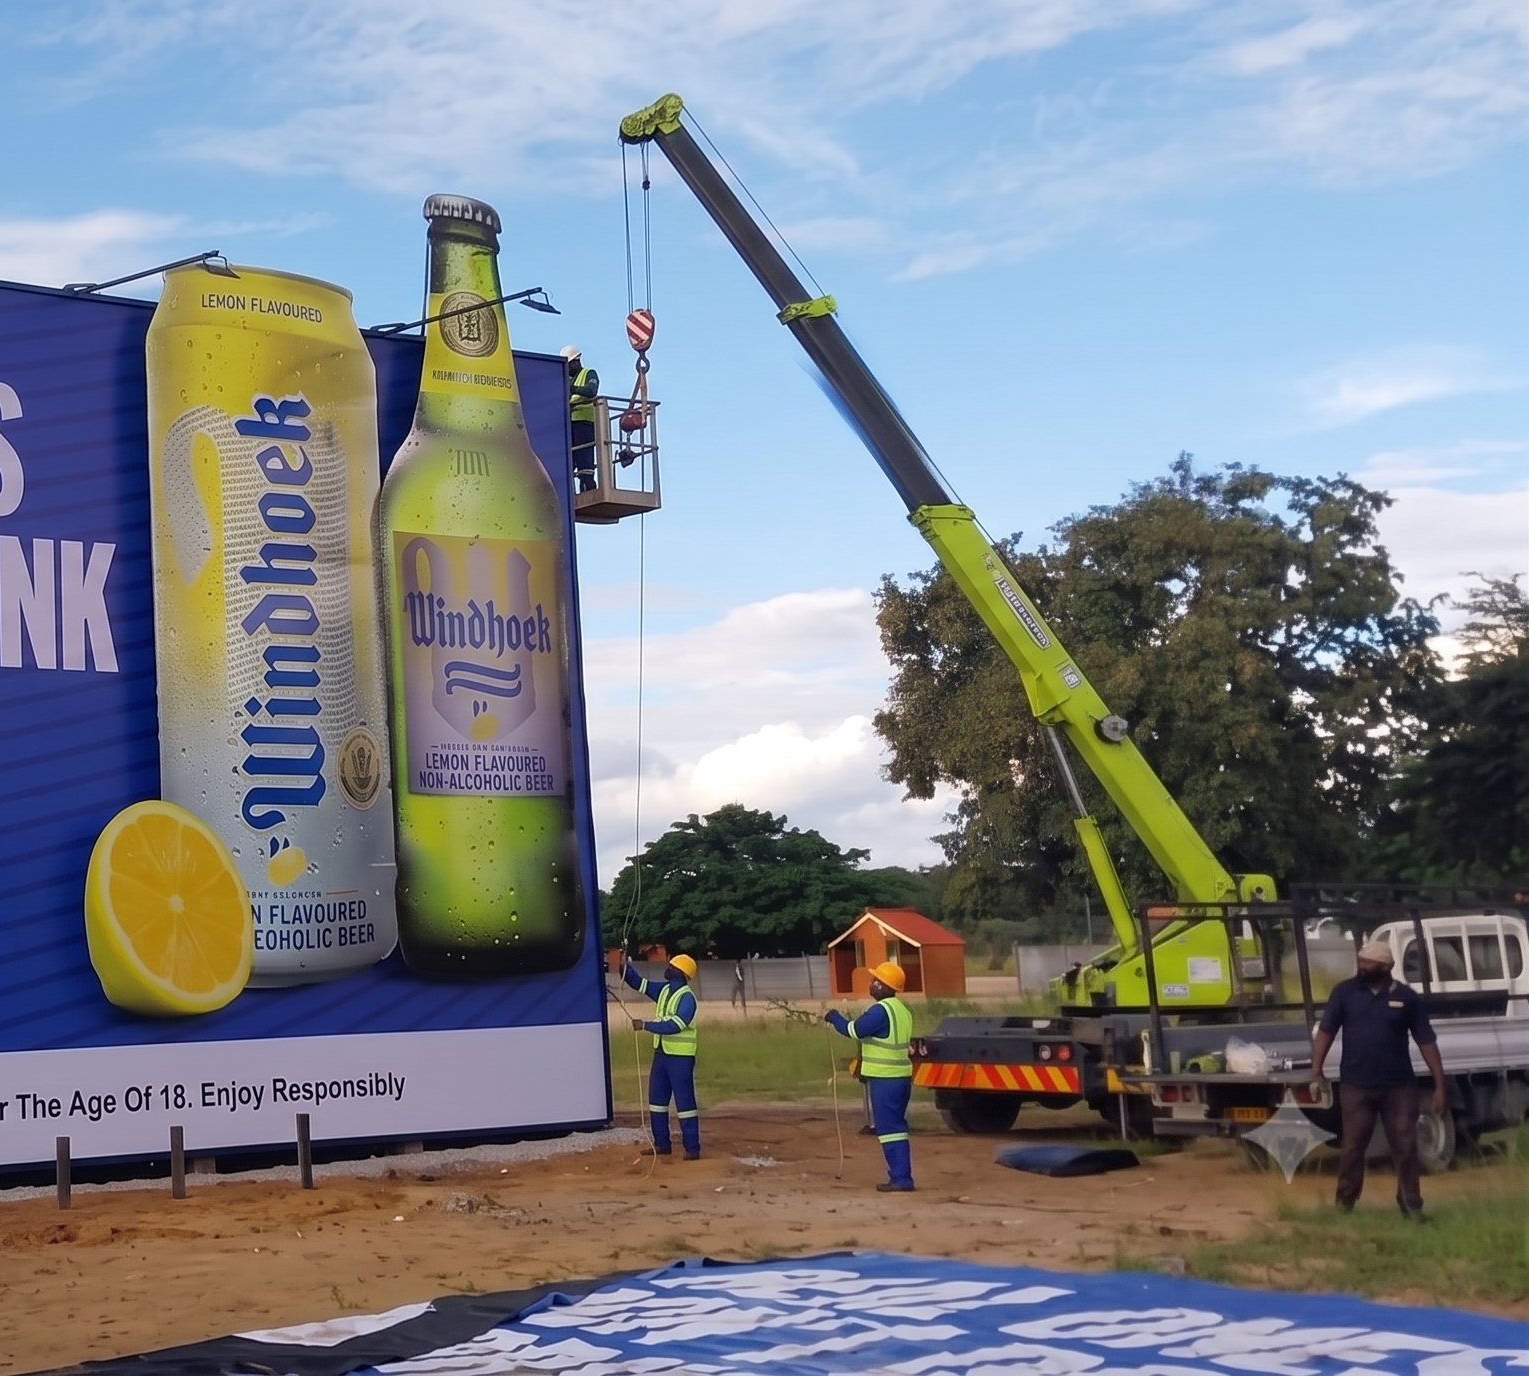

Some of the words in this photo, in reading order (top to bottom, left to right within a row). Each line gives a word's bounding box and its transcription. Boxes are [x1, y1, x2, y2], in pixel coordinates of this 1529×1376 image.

[201, 293, 246, 311] LEMON
[251, 297, 323, 324] FLAVOURED
[233, 390, 328, 831] Windhoek
[404, 590, 552, 659] Windhoek
[425, 752, 469, 771] LEMON
[475, 754, 547, 773] FLAVOURED
[419, 771, 522, 791] NON-ALCOHOLIC
[525, 774, 555, 791] BEER
[269, 900, 367, 925] FLAVOURED
[254, 928, 333, 950] EOHOLIC
[338, 923, 375, 947] BEER
[16, 1093, 62, 1120] The
[68, 1090, 117, 1122] Age
[124, 1086, 153, 1112] Of
[161, 1084, 194, 1110] 18.
[201, 1082, 265, 1113] Enjoy
[272, 1072, 406, 1106] Responsibly
